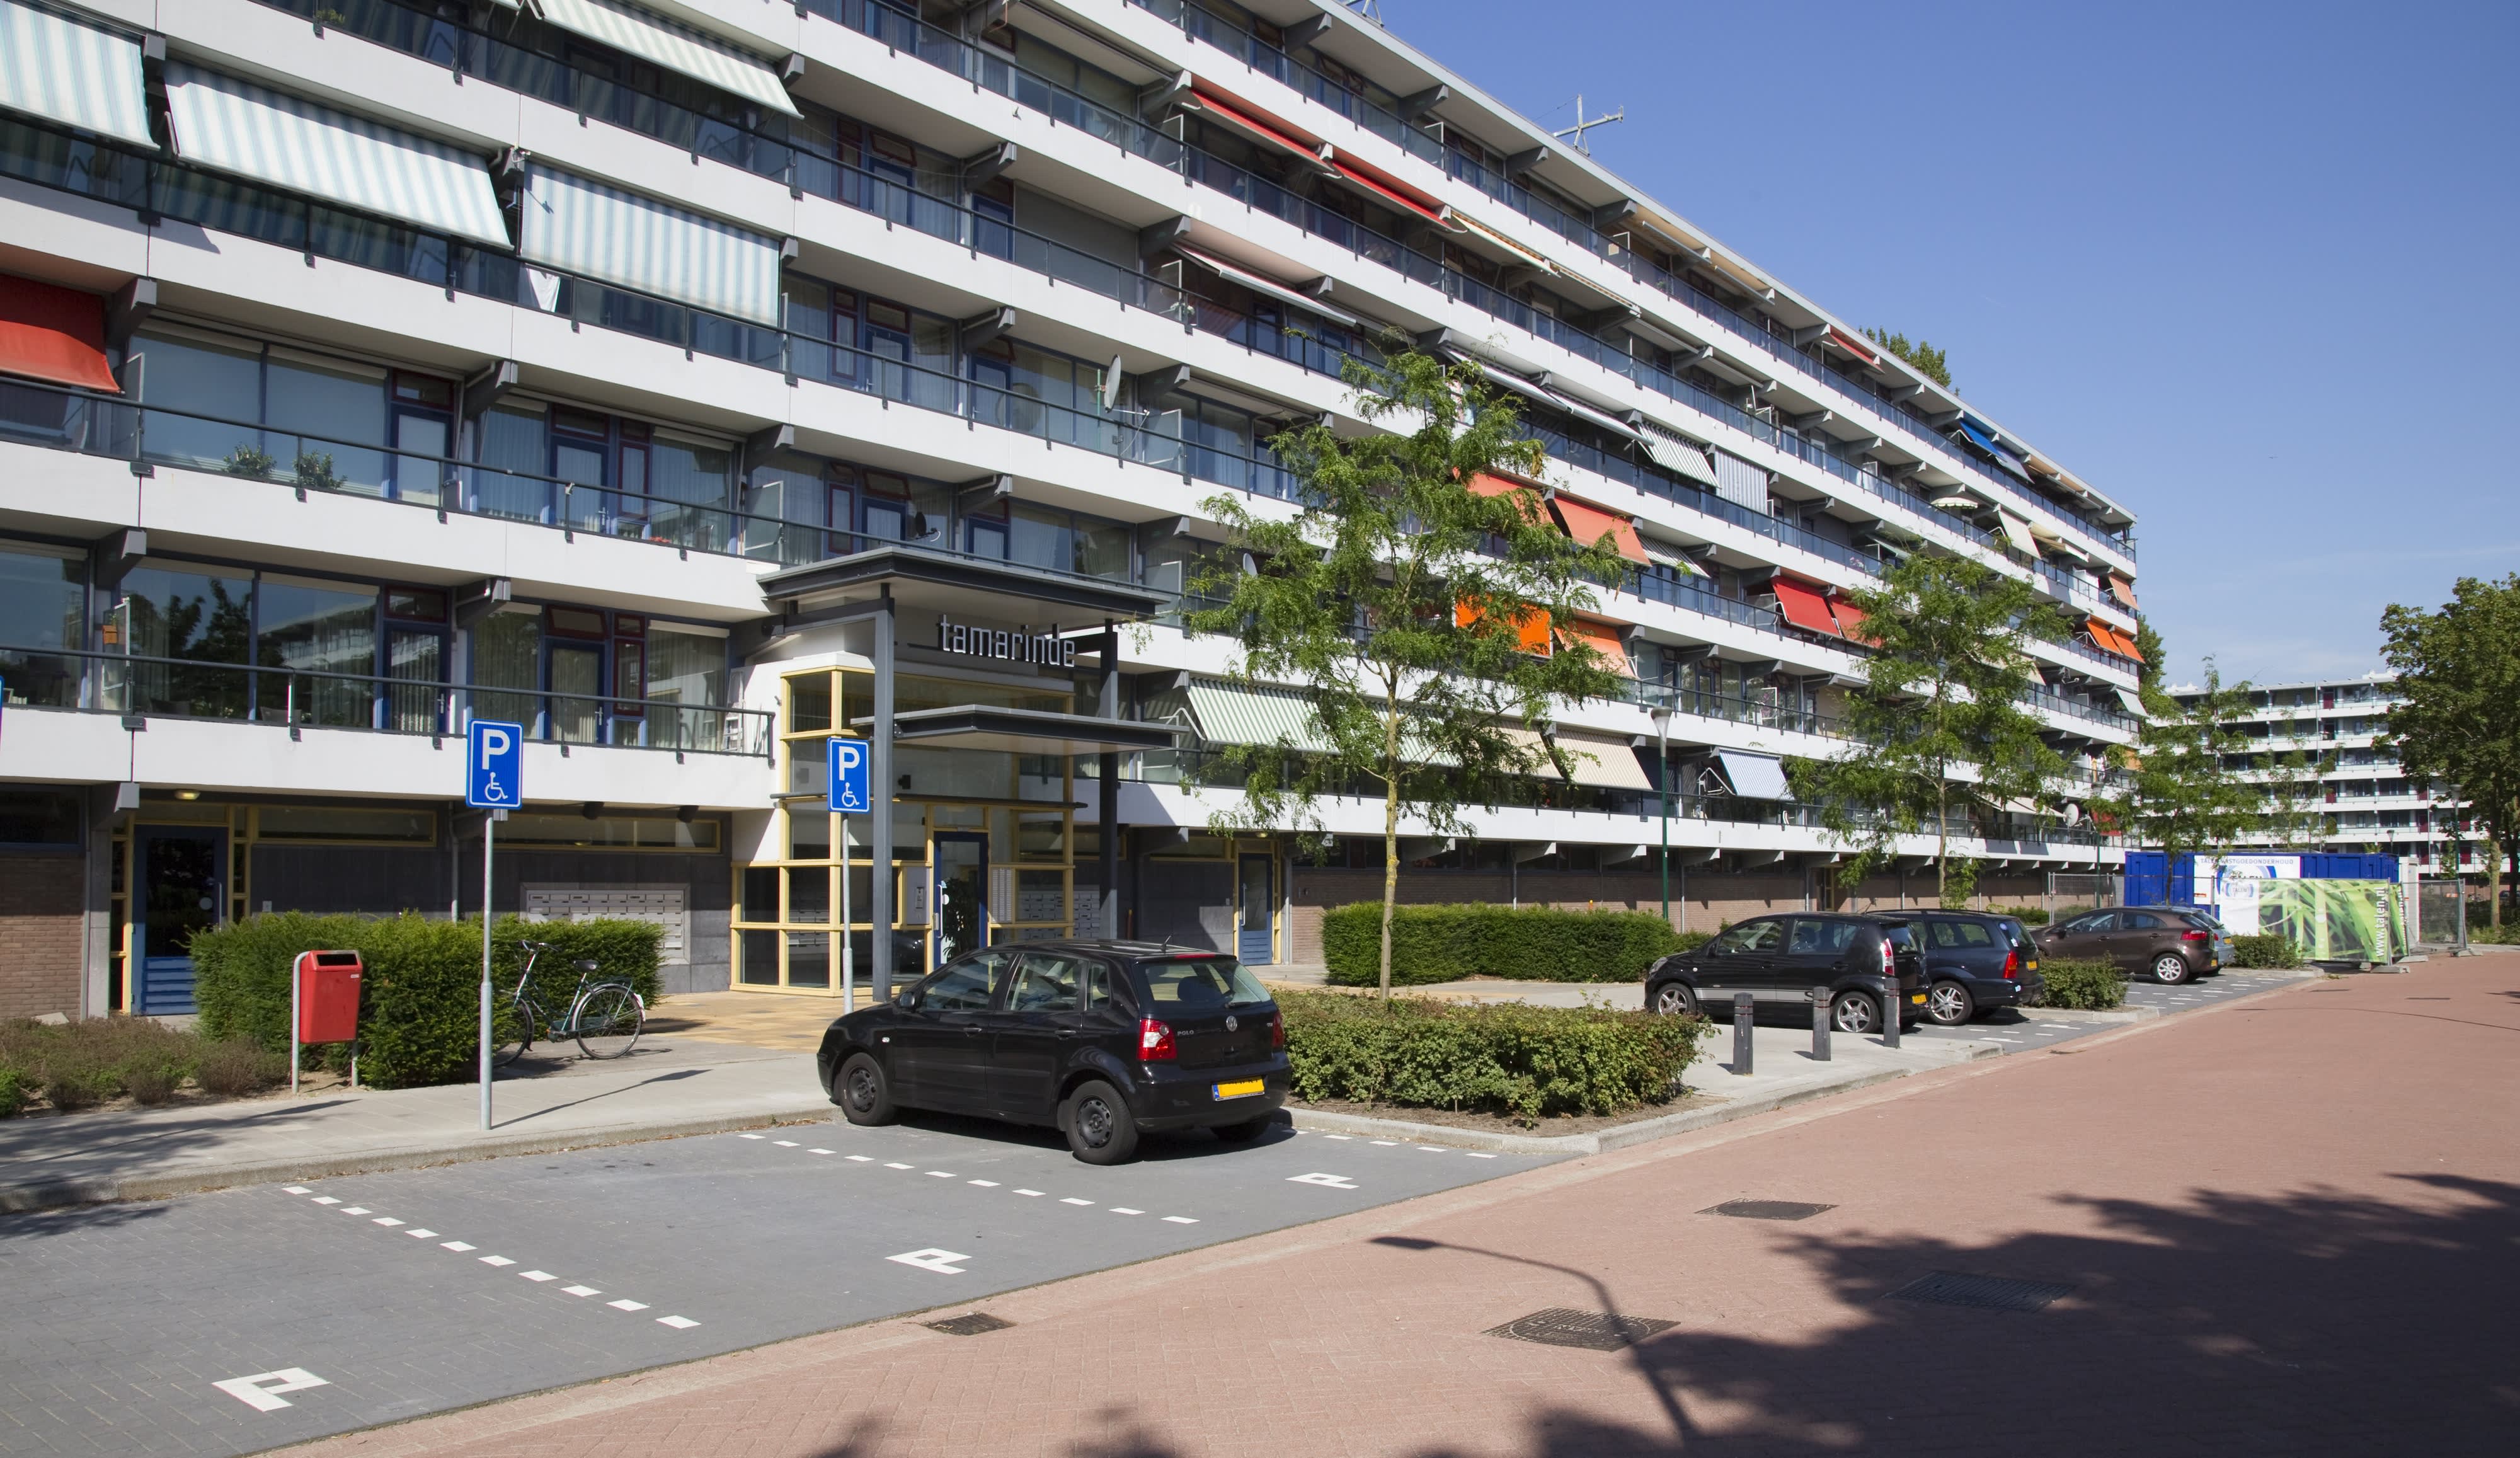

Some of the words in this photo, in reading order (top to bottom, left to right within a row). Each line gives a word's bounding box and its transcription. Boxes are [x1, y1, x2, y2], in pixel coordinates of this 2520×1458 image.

[941, 614, 1075, 667] tamarinde
[481, 728, 510, 770] P
[839, 745, 860, 781] P
[2374, 887, 2385, 957] www.talen.nl
